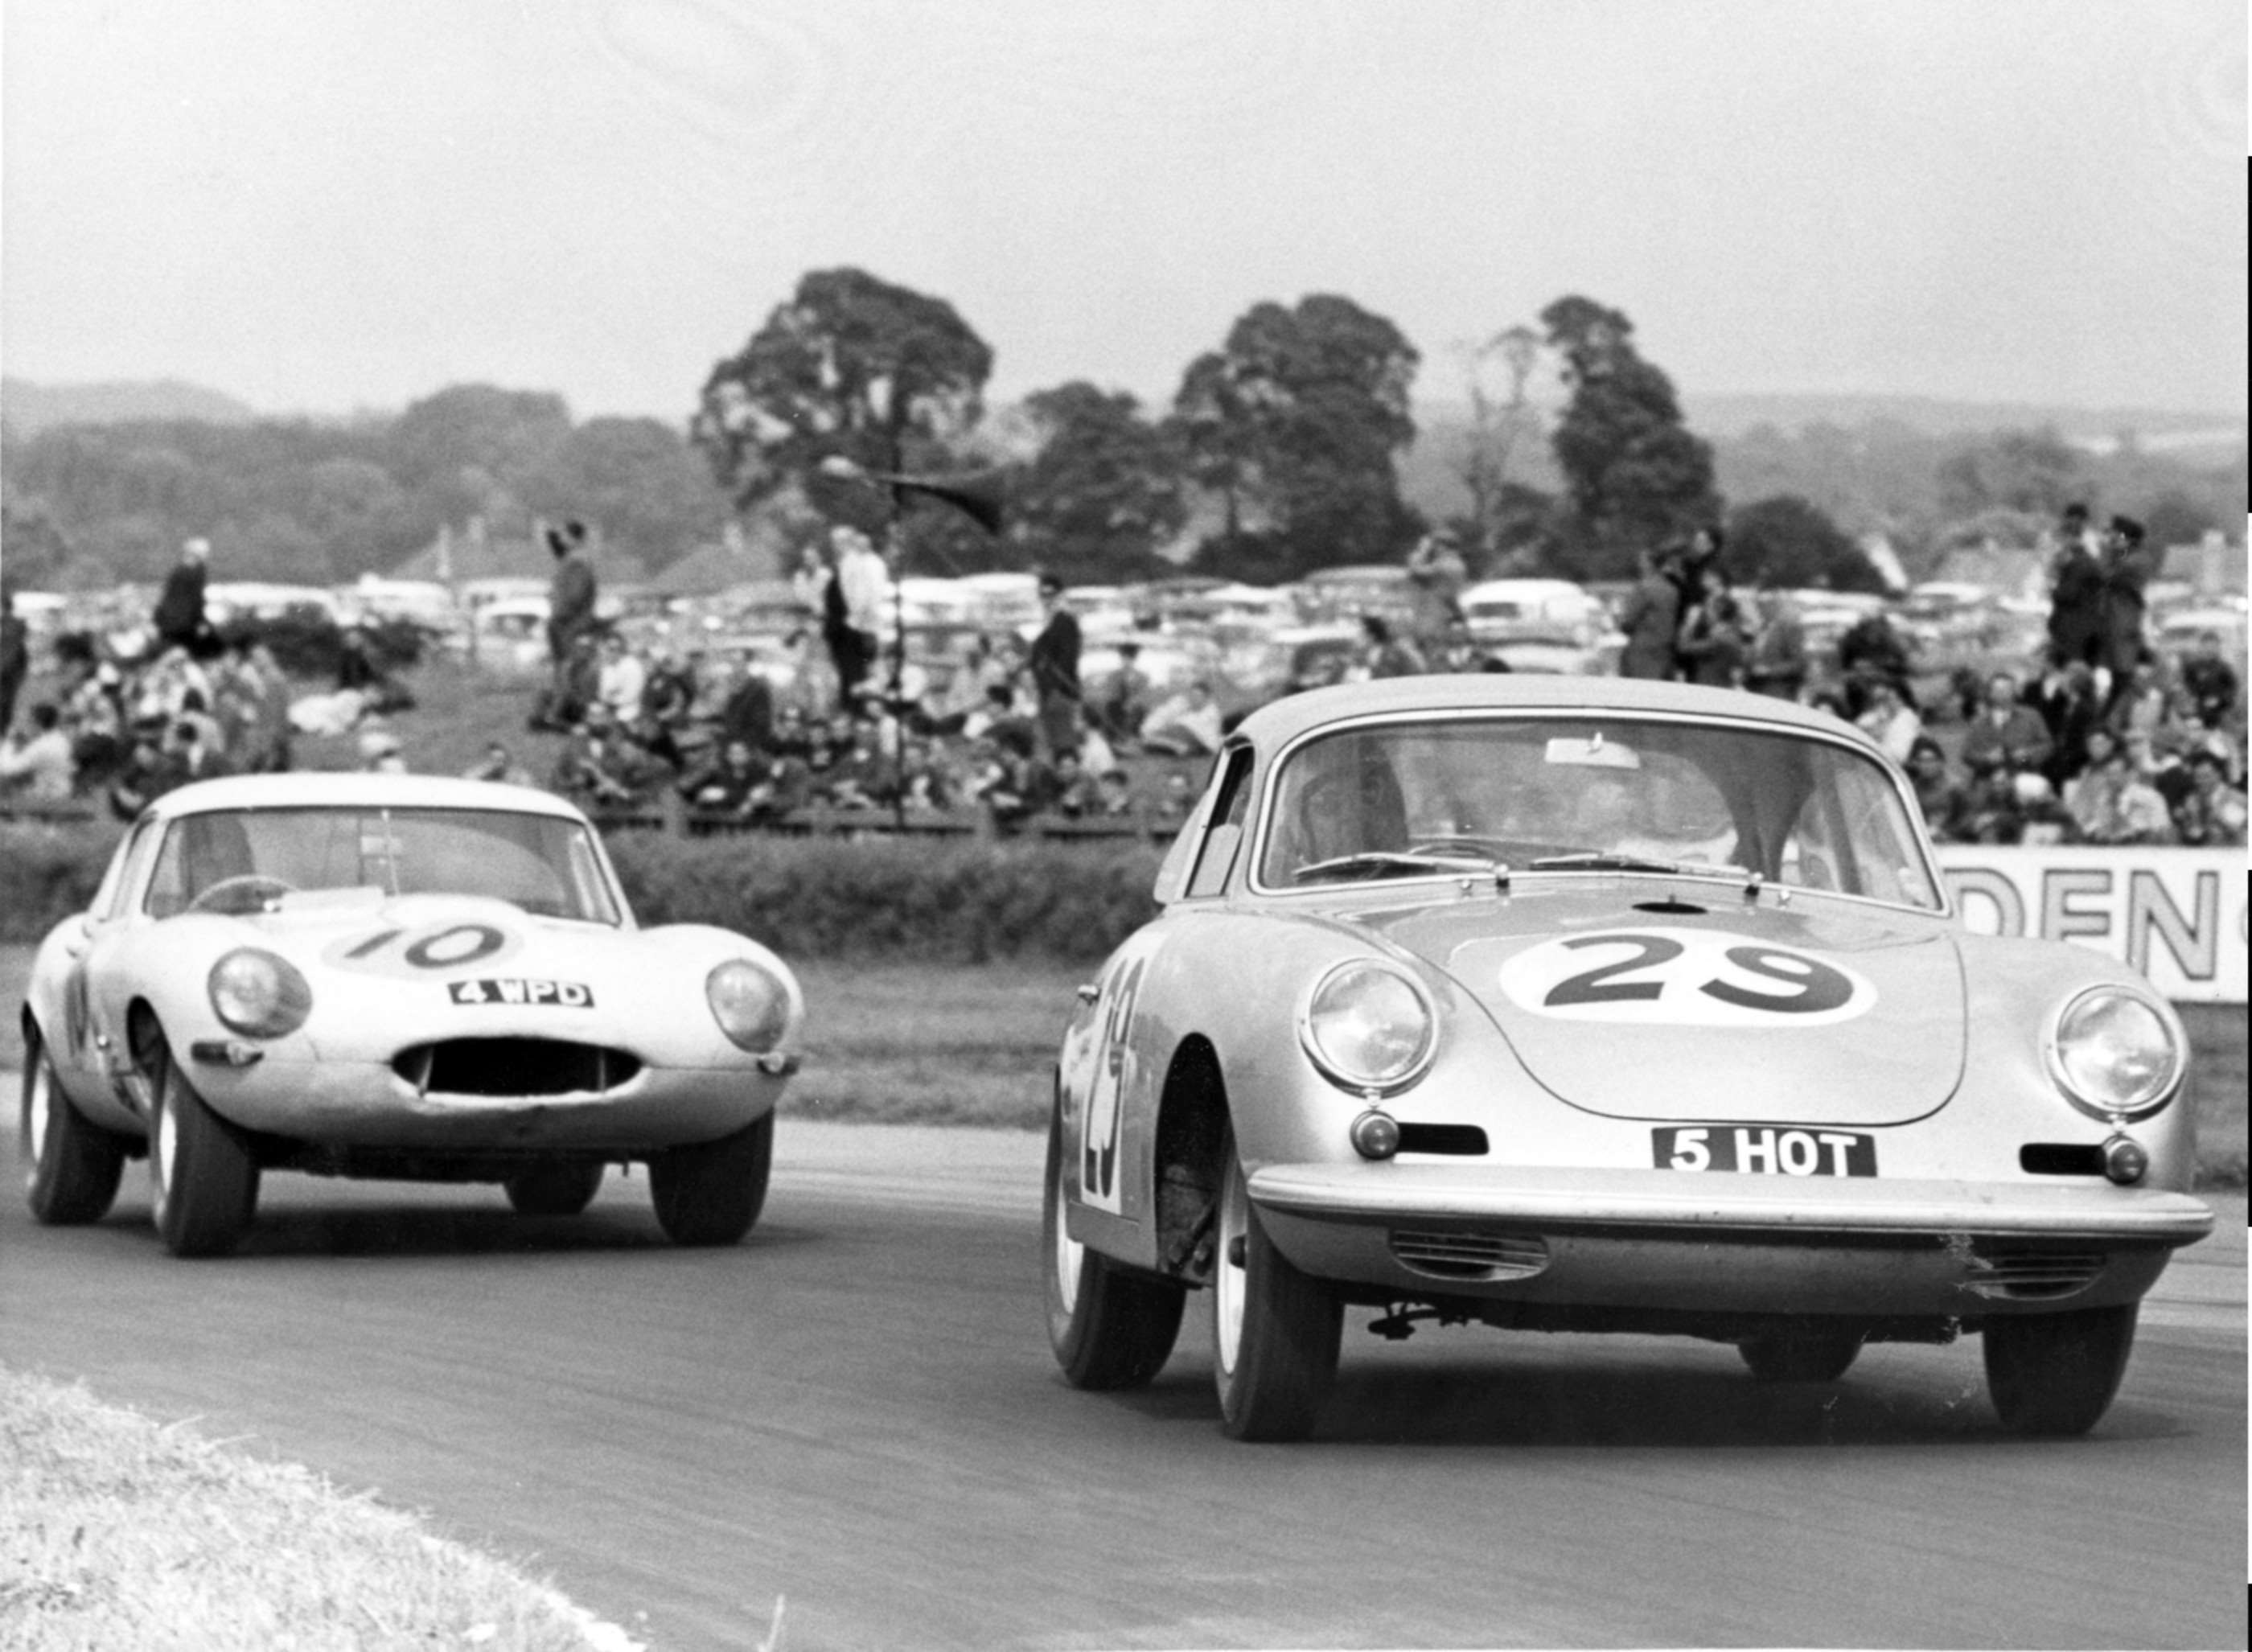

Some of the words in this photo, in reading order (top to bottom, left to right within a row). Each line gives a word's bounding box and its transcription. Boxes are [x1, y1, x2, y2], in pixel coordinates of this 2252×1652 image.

[343, 925, 505, 969] 10
[1942, 867, 2248, 980] DEN
[457, 979, 488, 1005] 4
[495, 979, 588, 1006] WPD
[1543, 934, 1854, 1013] 29
[1670, 1128, 1711, 1173] 5
[1734, 1128, 1857, 1177] HOT
